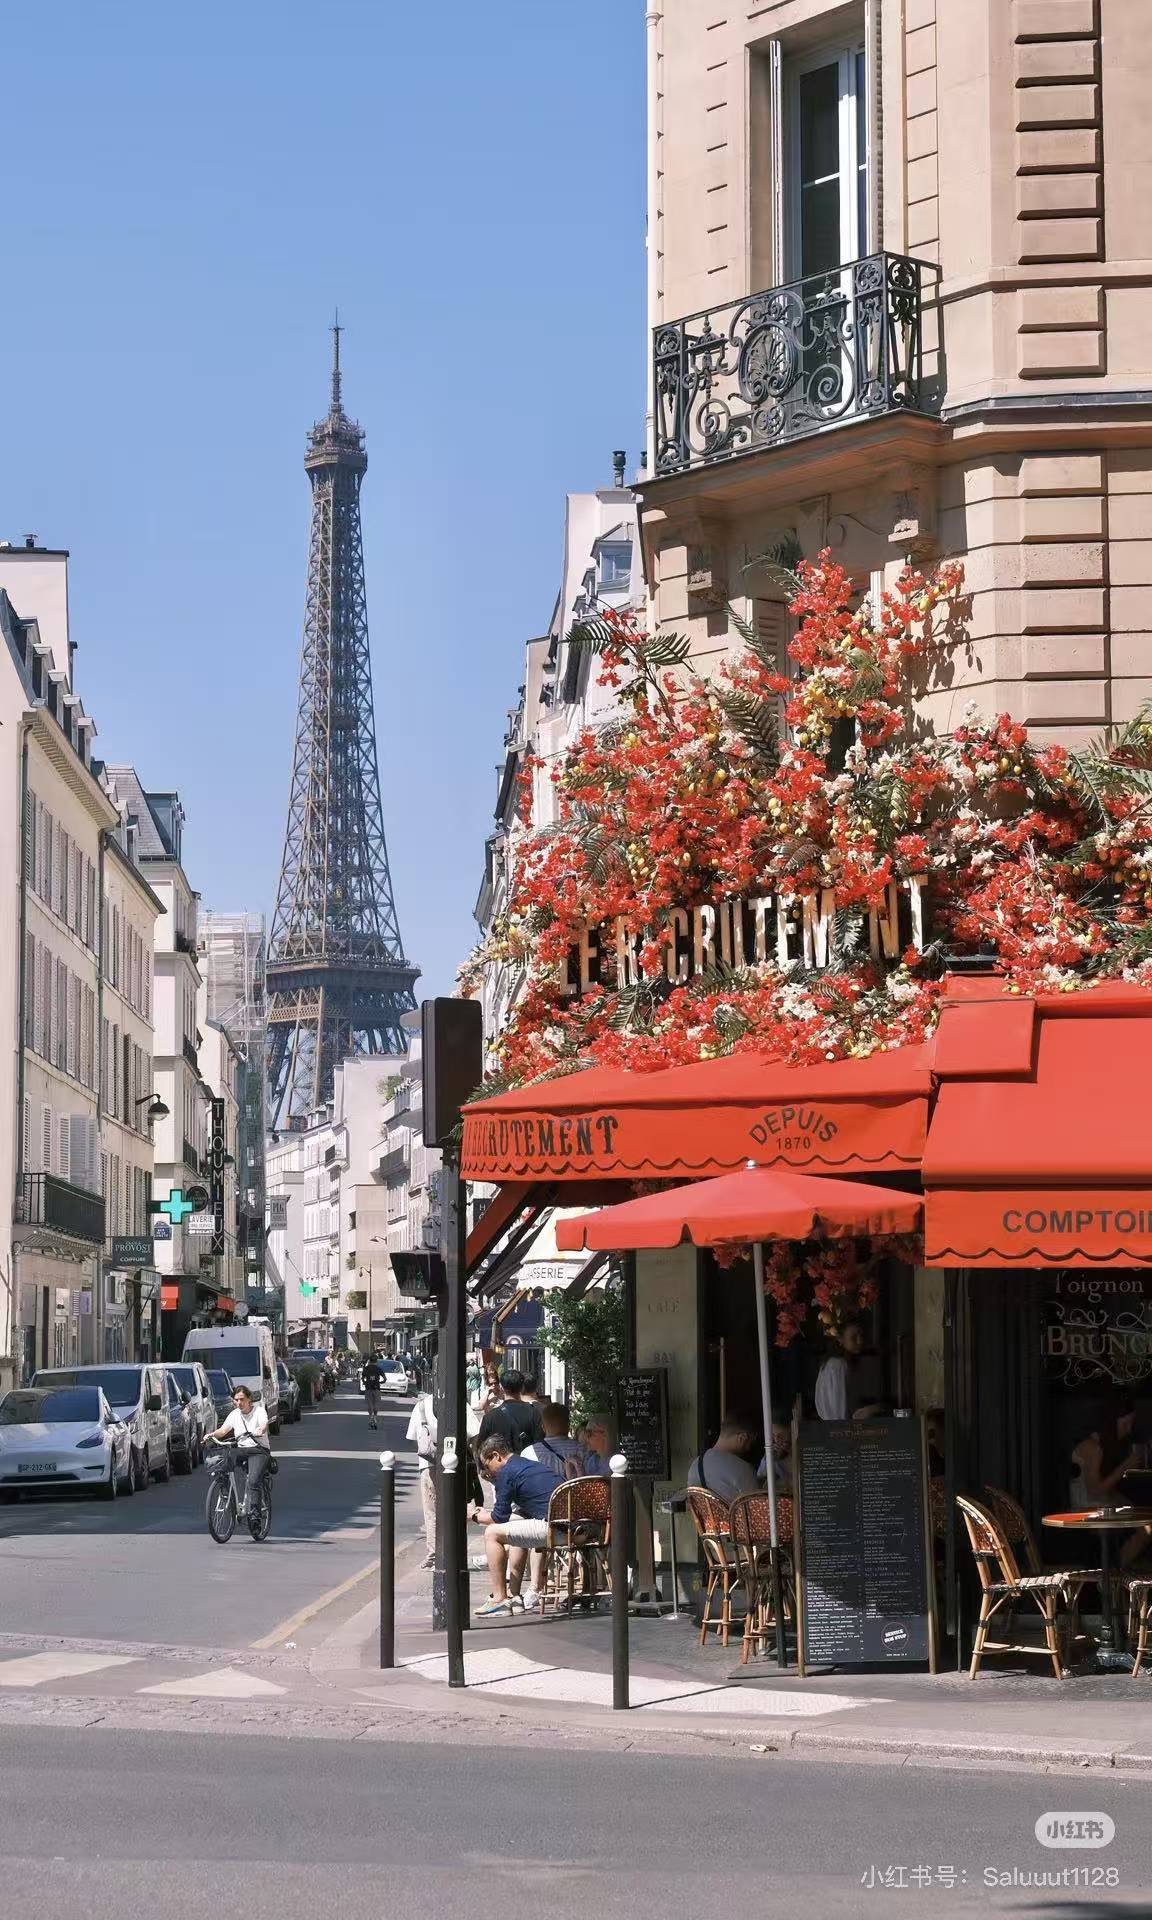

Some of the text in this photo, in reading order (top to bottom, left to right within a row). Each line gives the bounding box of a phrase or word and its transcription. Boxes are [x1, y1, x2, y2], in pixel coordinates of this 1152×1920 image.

[749, 1107, 838, 1146] DEPUIS
[776, 1136, 811, 1150] 1870
[213, 1102, 224, 1250] THOUMIEUX
